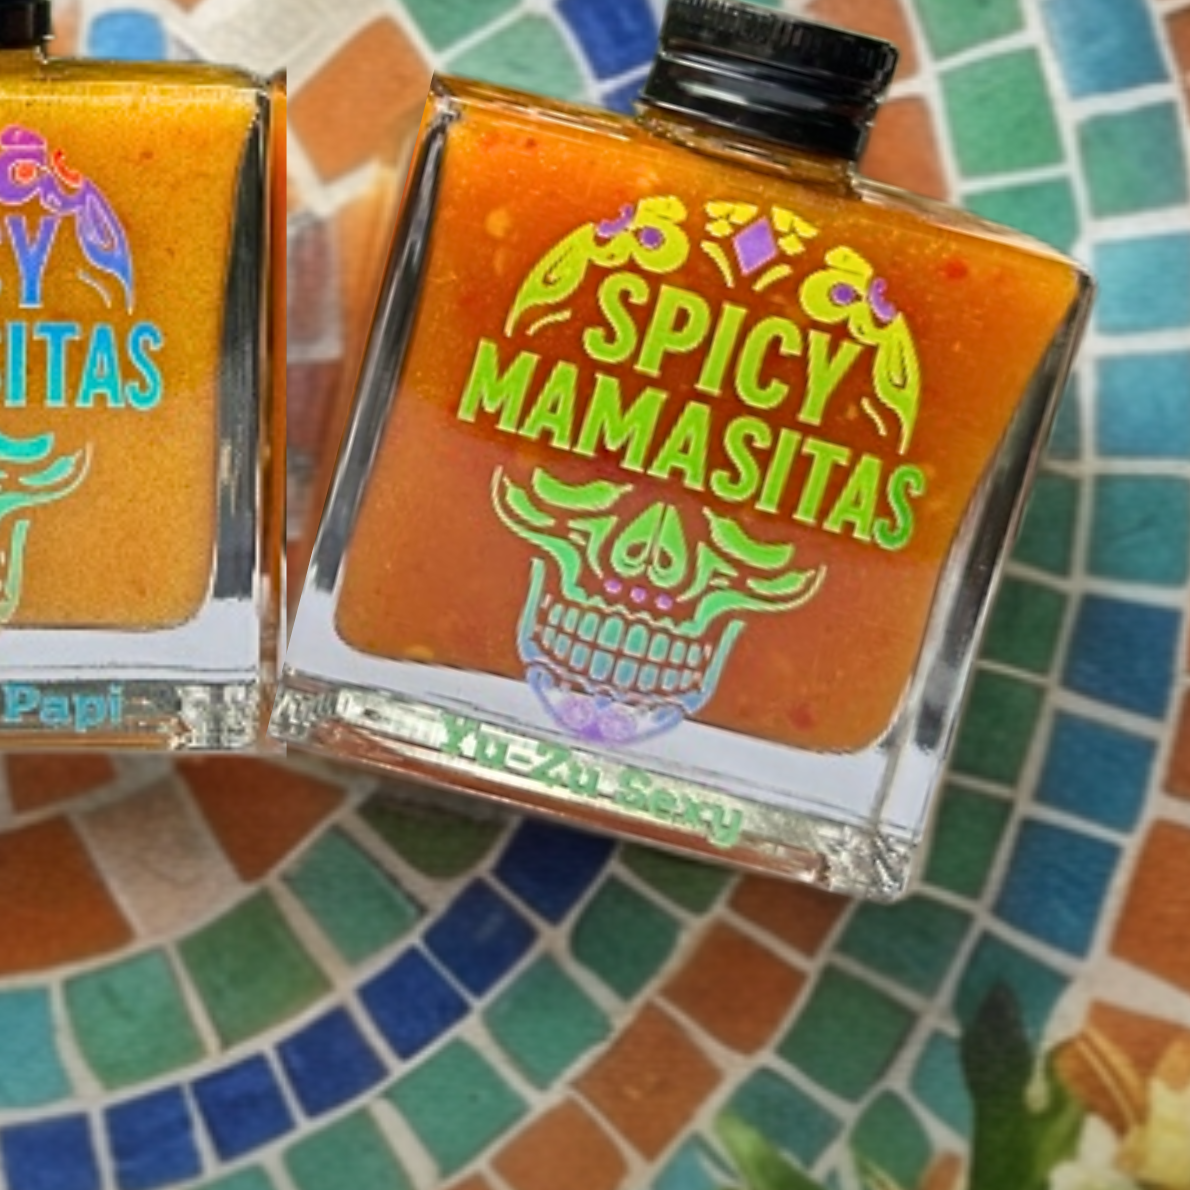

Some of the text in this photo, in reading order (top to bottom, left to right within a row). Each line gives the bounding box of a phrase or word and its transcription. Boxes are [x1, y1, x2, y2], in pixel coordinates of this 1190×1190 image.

[582, 273, 863, 426] SPICY
[458, 339, 926, 552] MAMASITAS
[1, 681, 124, 732] Papi
[615, 770, 743, 846] Sexy
